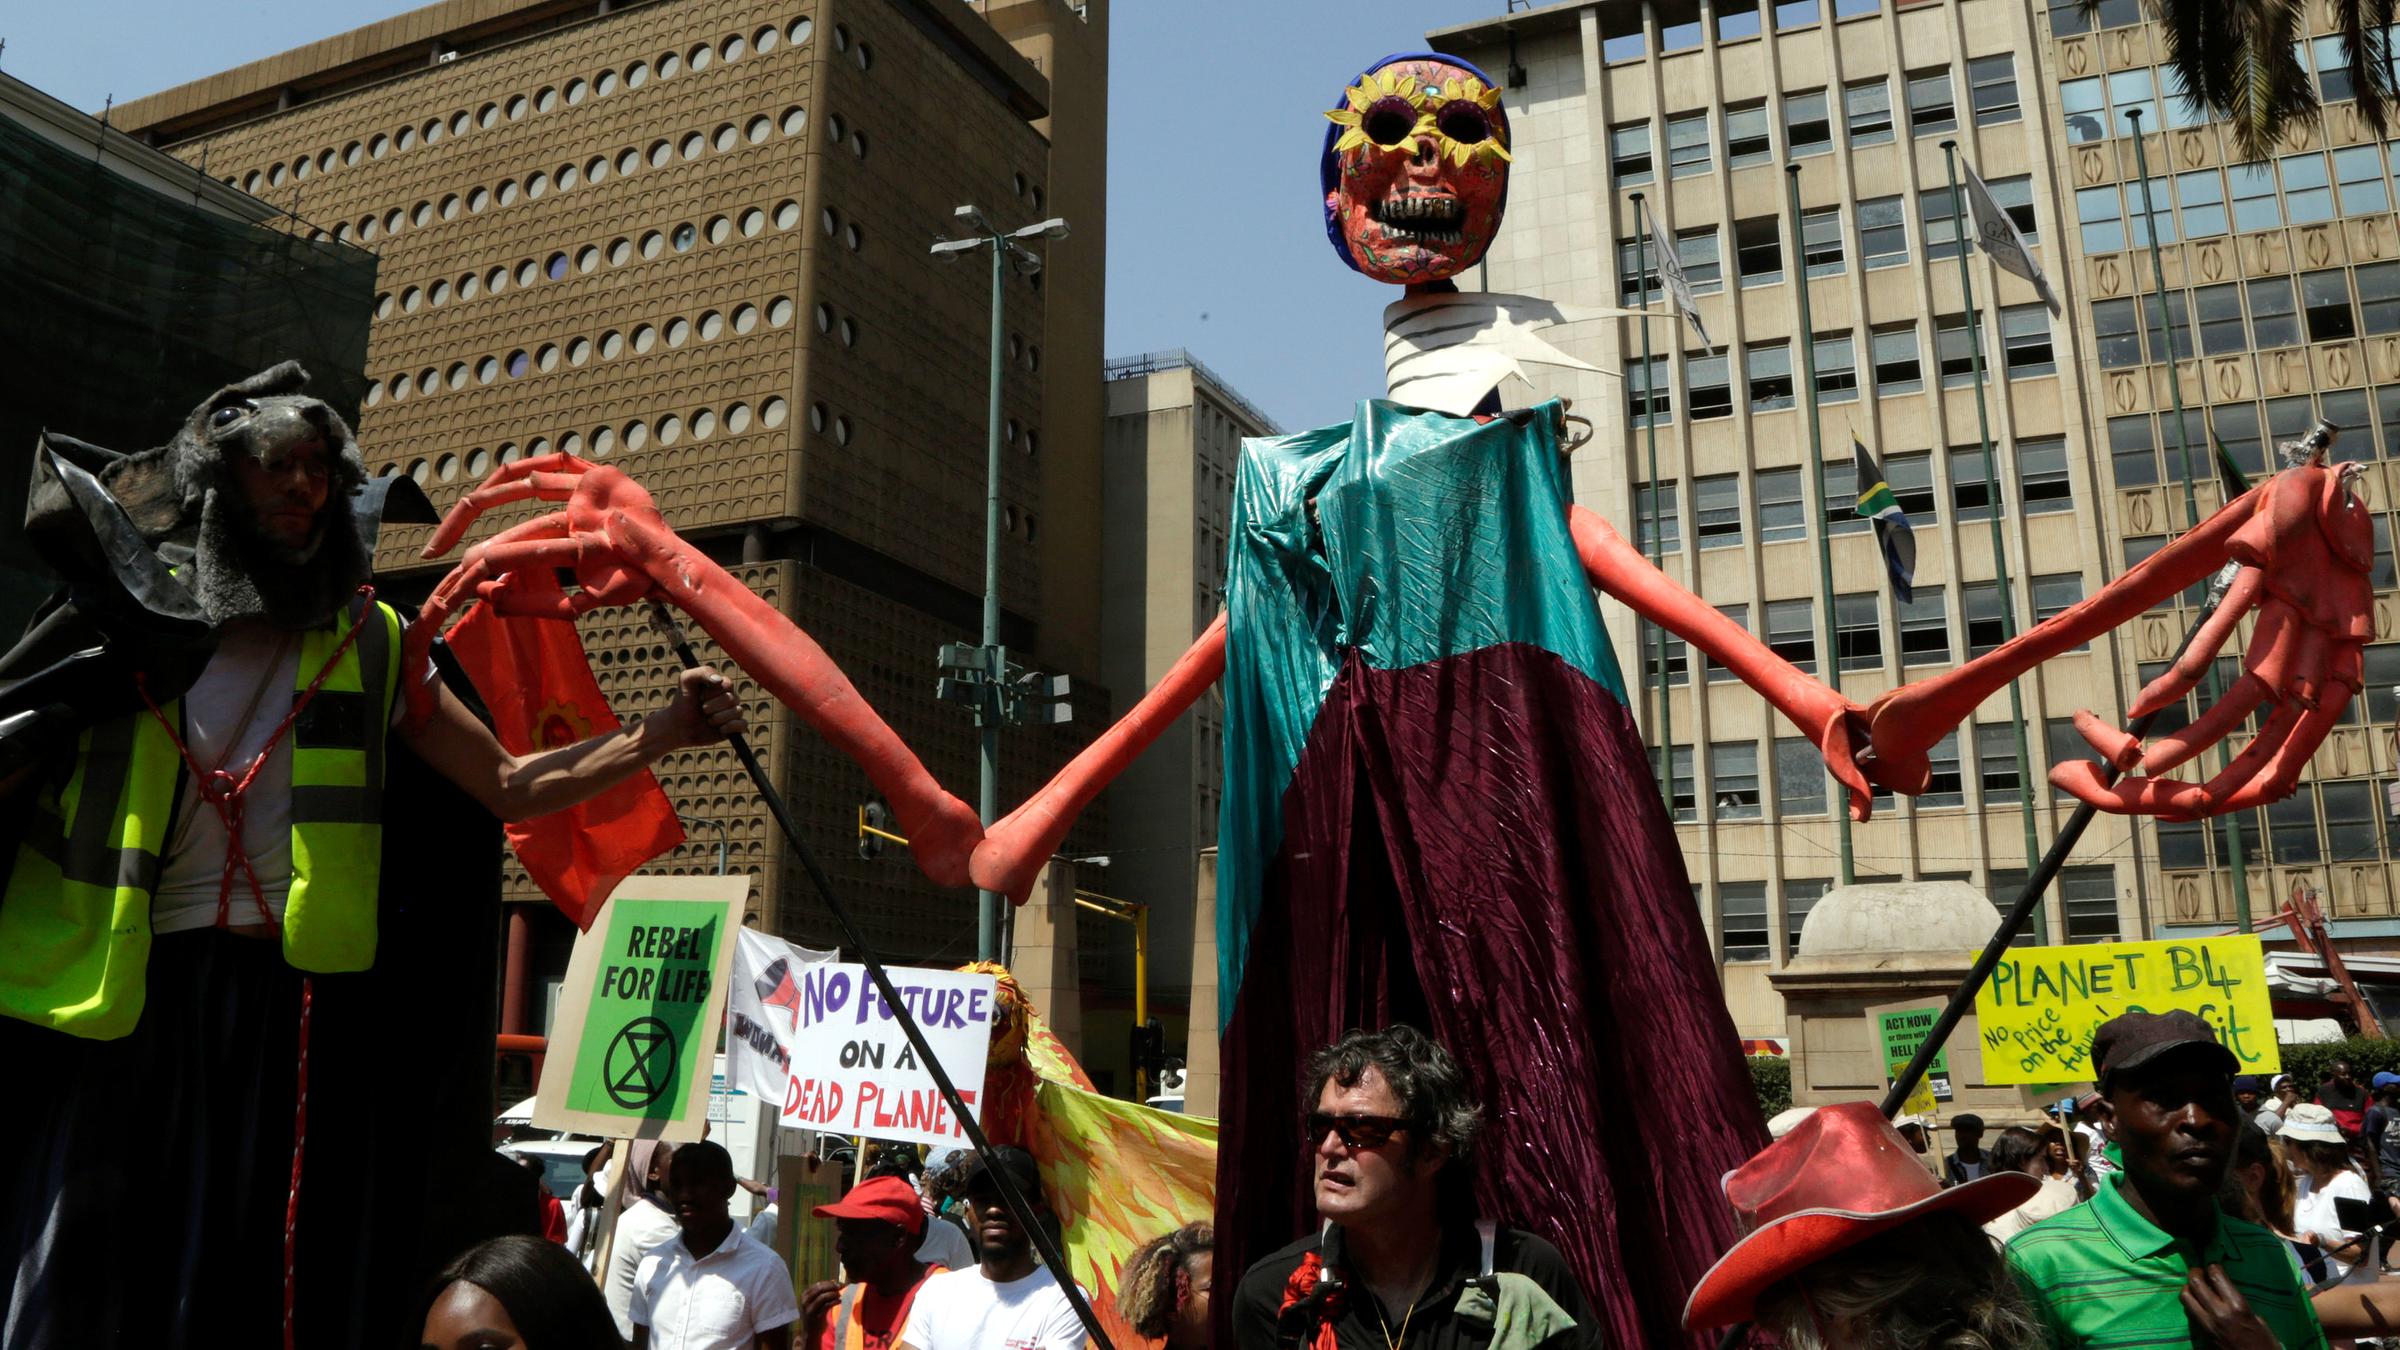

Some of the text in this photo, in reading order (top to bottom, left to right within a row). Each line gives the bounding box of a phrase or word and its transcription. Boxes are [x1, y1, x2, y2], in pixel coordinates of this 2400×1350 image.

[627, 926, 701, 960] REBEL
[601, 966, 711, 1003] FOR LIFE
[1992, 946, 2242, 1006] PLANET B4
[804, 967, 988, 1029] NO FUTURE
[1886, 1014, 1932, 1030] ACT NOW
[1984, 1026, 2008, 1051] NO
[839, 1040, 917, 1070] ON A
[1890, 1044, 1913, 1057] HELL
[2020, 1028, 2072, 1073] on the
[783, 1074, 976, 1138] DEAD PLANET
